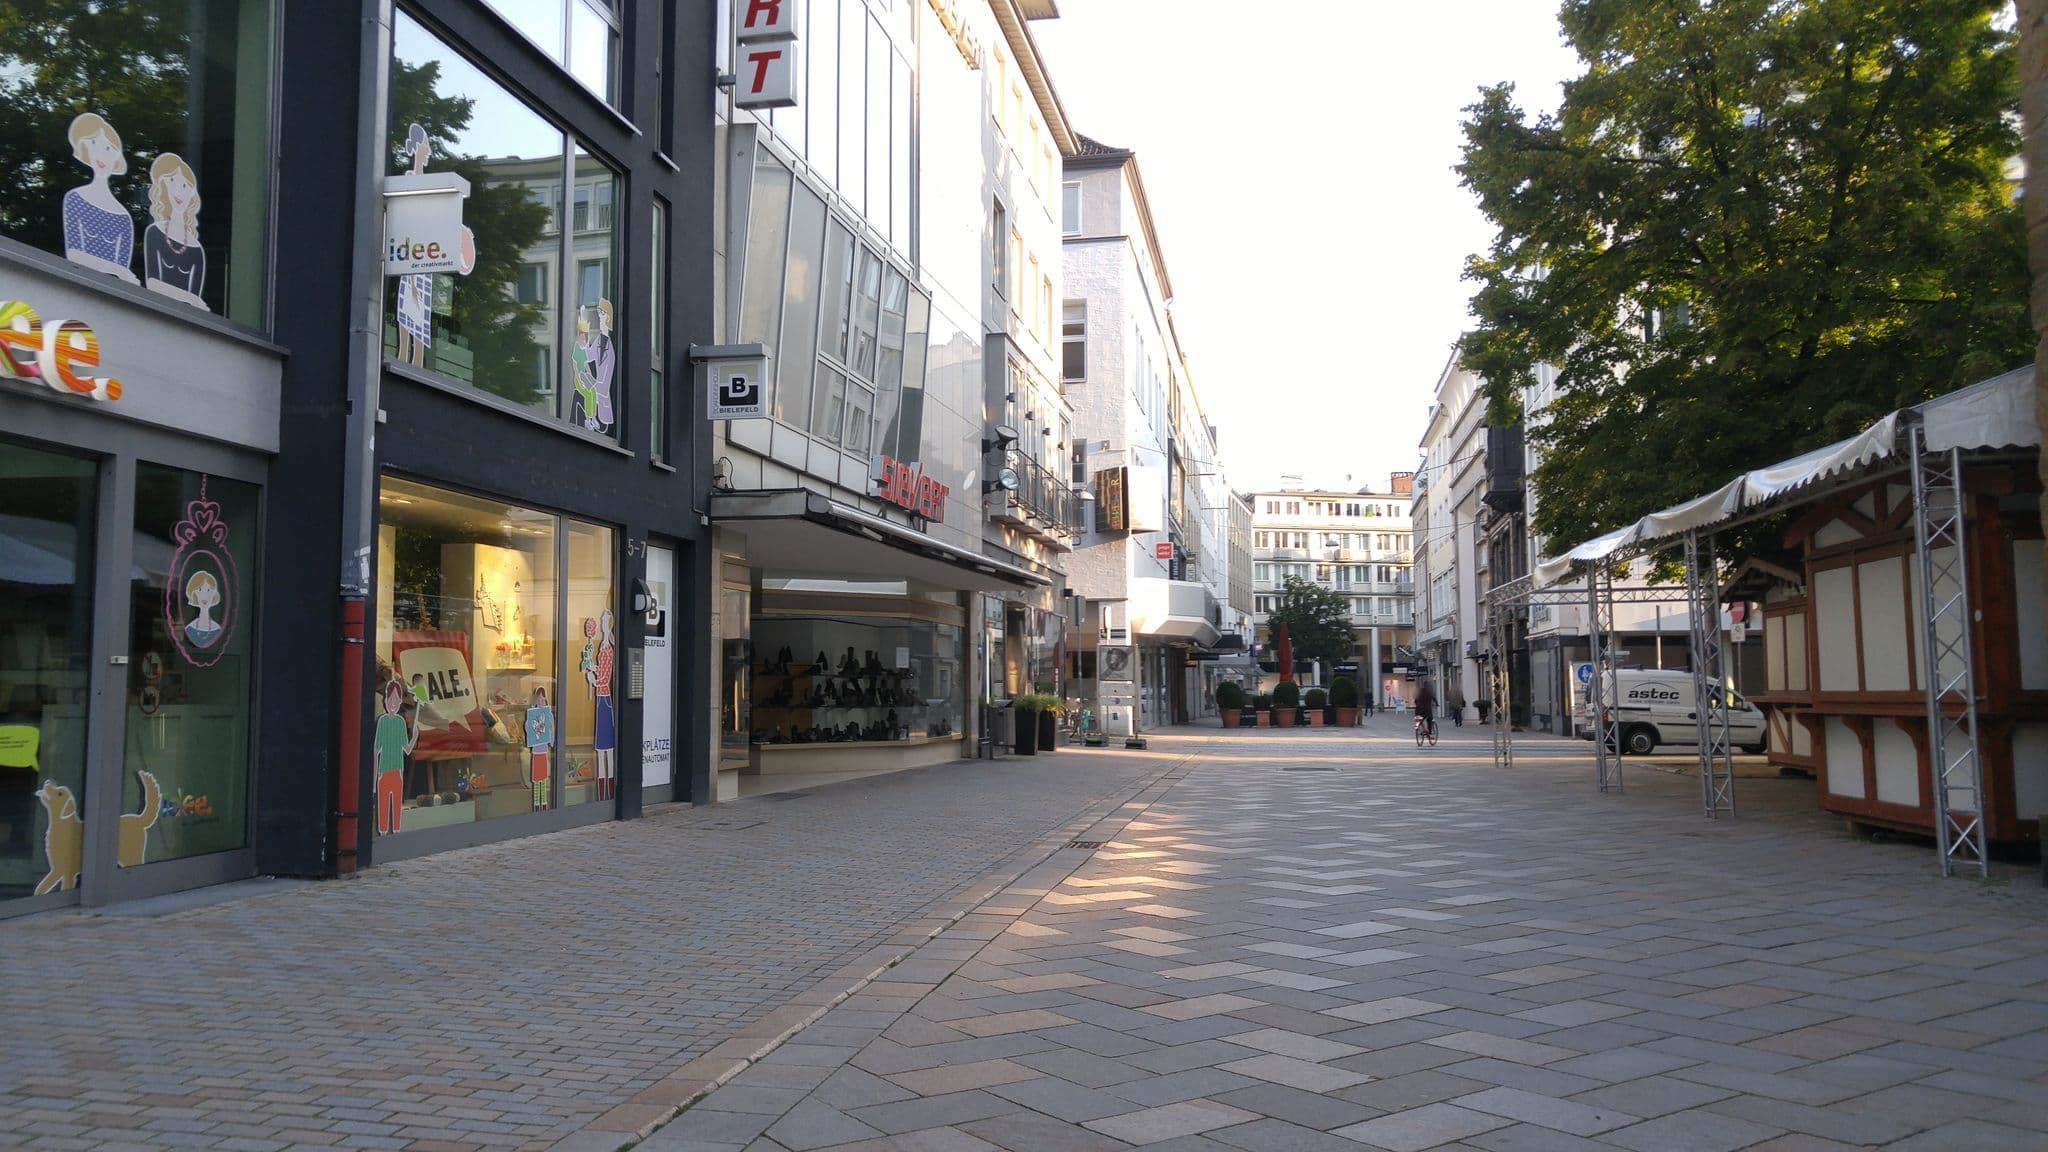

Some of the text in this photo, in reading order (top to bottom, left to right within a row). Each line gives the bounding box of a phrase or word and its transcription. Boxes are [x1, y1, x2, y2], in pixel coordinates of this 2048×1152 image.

[390, 237, 447, 261] idee.
[732, 377, 746, 393] B
[627, 539, 647, 558] 5-7
[644, 639, 665, 647] ELEFELD
[1628, 688, 1680, 699] astec
